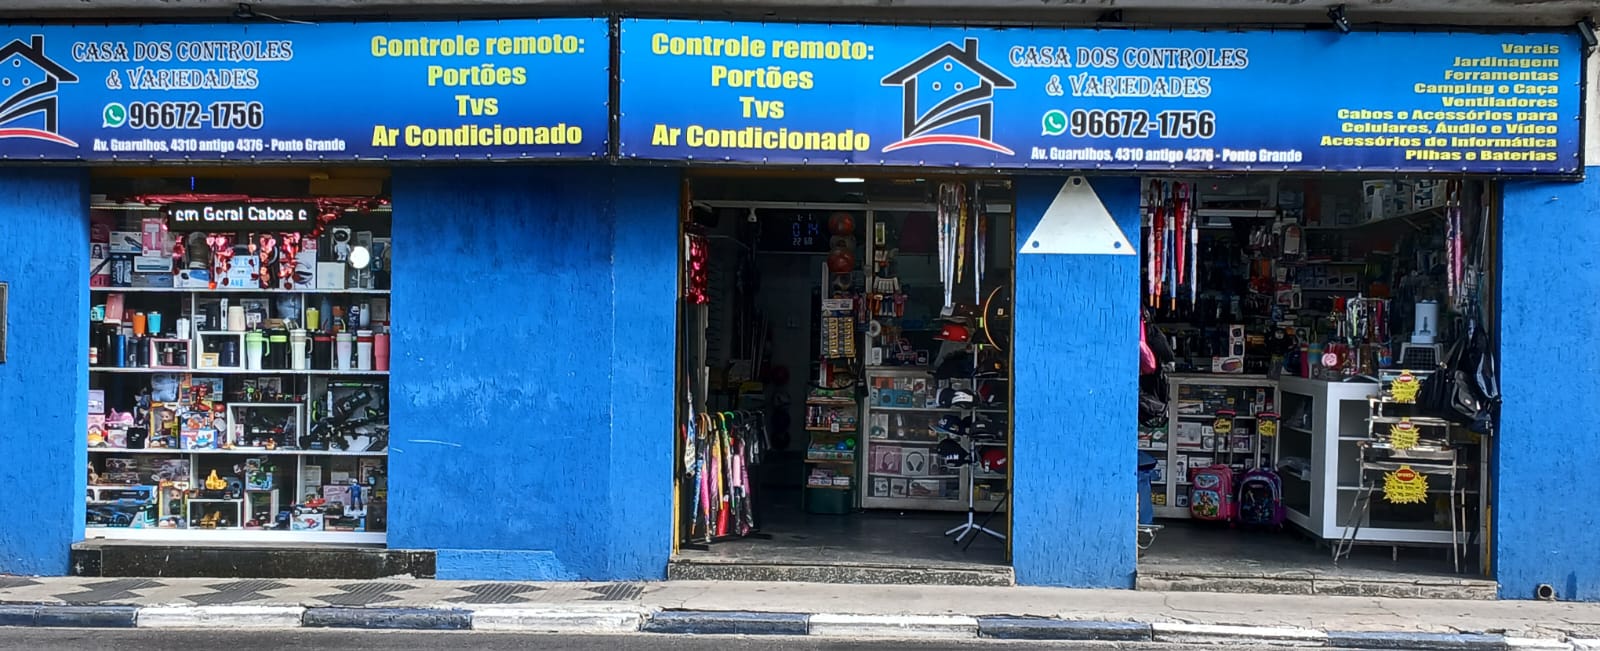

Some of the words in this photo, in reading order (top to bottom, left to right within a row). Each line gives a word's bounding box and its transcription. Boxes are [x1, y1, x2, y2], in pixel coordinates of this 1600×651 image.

[72, 41, 129, 62] CASA
[133, 41, 172, 61] DOS
[175, 40, 293, 63] CONTROLES
[371, 35, 480, 57] Controle
[485, 34, 585, 55] remoto:
[651, 33, 766, 58] Controle
[772, 39, 874, 60] remoto:
[1502, 43, 1560, 54] Varais
[1008, 45, 1070, 68] CASA
[1075, 46, 1118, 68] DOS
[1122, 46, 1249, 70] CONTROLES
[1453, 56, 1559, 68] Jardinagem
[106, 69, 122, 89] &
[127, 66, 259, 91] VARIEDADES
[427, 63, 527, 87] Portões
[711, 65, 814, 90] Portões
[1045, 75, 1063, 96] &
[1068, 72, 1212, 98] VARIEDADES
[1444, 69, 1560, 81] Ferramentas
[1414, 83, 1495, 95] Camping
[1498, 85, 1509, 94] e
[1513, 83, 1559, 96] Caça
[454, 94, 499, 116] Tvs
[739, 96, 785, 119] Tvs
[1442, 97, 1559, 108] Ventiladores
[128, 101, 263, 129] 96672-1756
[1070, 109, 1216, 139] 96672-1756
[1337, 109, 1394, 120] Cabos
[1397, 111, 1408, 120] e
[1411, 108, 1513, 121] Acessórios
[1516, 111, 1558, 122] para
[371, 125, 400, 147] Ar
[404, 123, 583, 147] Condicionado
[651, 124, 681, 146] Ar
[686, 125, 871, 151] Condicionado
[1341, 122, 1432, 135] Celulares,
[1435, 121, 1487, 134] Áudio
[1490, 125, 1502, 134] e
[1506, 123, 1558, 134] Vídeo
[93, 139, 109, 152] Av.
[110, 139, 169, 153] Guarulhos,
[170, 139, 197, 151] 4310
[199, 139, 234, 153] antigo
[236, 139, 263, 151] 4376
[271, 139, 303, 151] Ponte
[305, 138, 346, 151] Grande
[1320, 135, 1421, 147] Acessórios
[1424, 136, 1447, 147] de
[1451, 136, 1557, 148] Informática
[1030, 146, 1048, 161] Av.
[1050, 147, 1113, 162] Guarulhos,
[1115, 147, 1143, 161] 4310
[1145, 148, 1183, 163] antigo
[1185, 148, 1213, 162] 4376
[1222, 148, 1257, 162] Ponte
[1258, 148, 1303, 162] Grande
[1405, 149, 1462, 161] Pilhas
[1465, 152, 1476, 161] e
[1480, 150, 1557, 161] Baterias
[203, 206, 243, 221] Geral
[248, 206, 293, 221] Cabos
